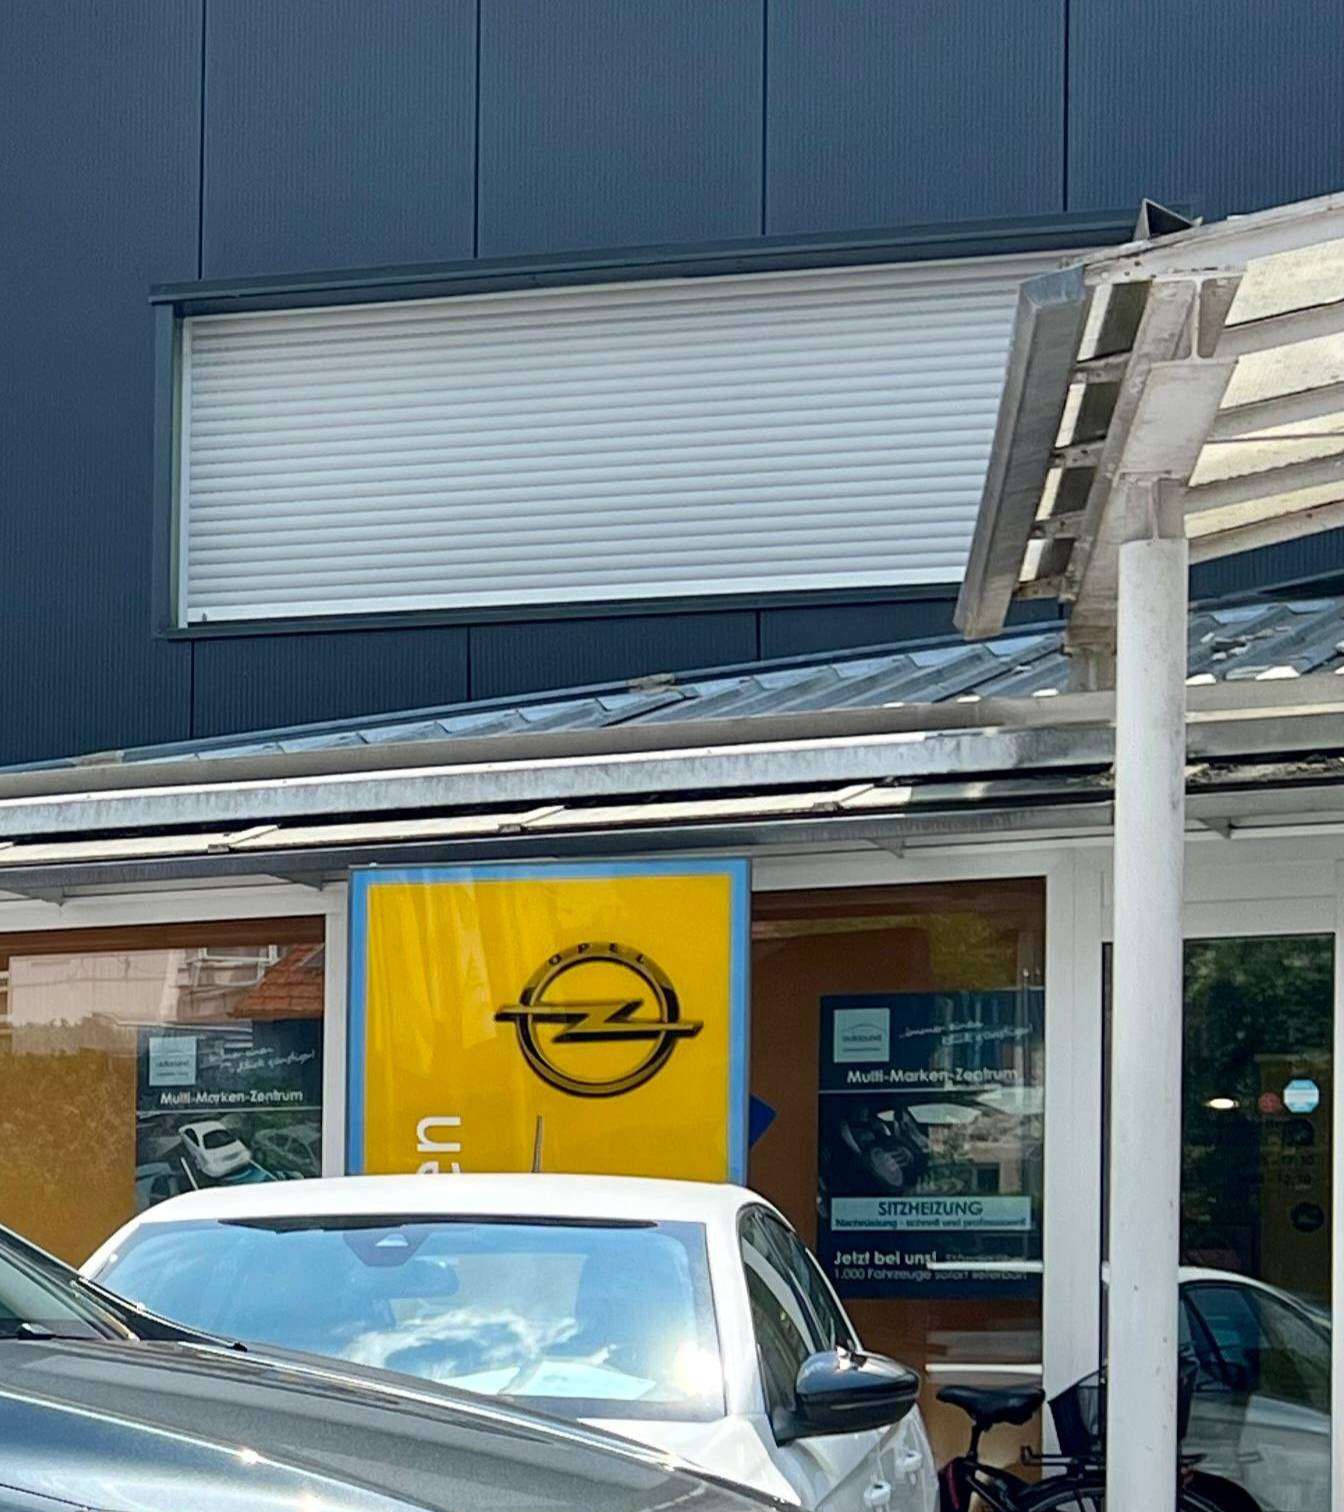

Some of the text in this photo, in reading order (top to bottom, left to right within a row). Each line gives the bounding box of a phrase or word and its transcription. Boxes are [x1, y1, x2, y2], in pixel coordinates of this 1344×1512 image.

[548, 942, 647, 965] OPEL
[878, 1200, 984, 1217] SITZHEIZUNG
[834, 1251, 870, 1266] Jetzt
[874, 1251, 901, 1265] bei
